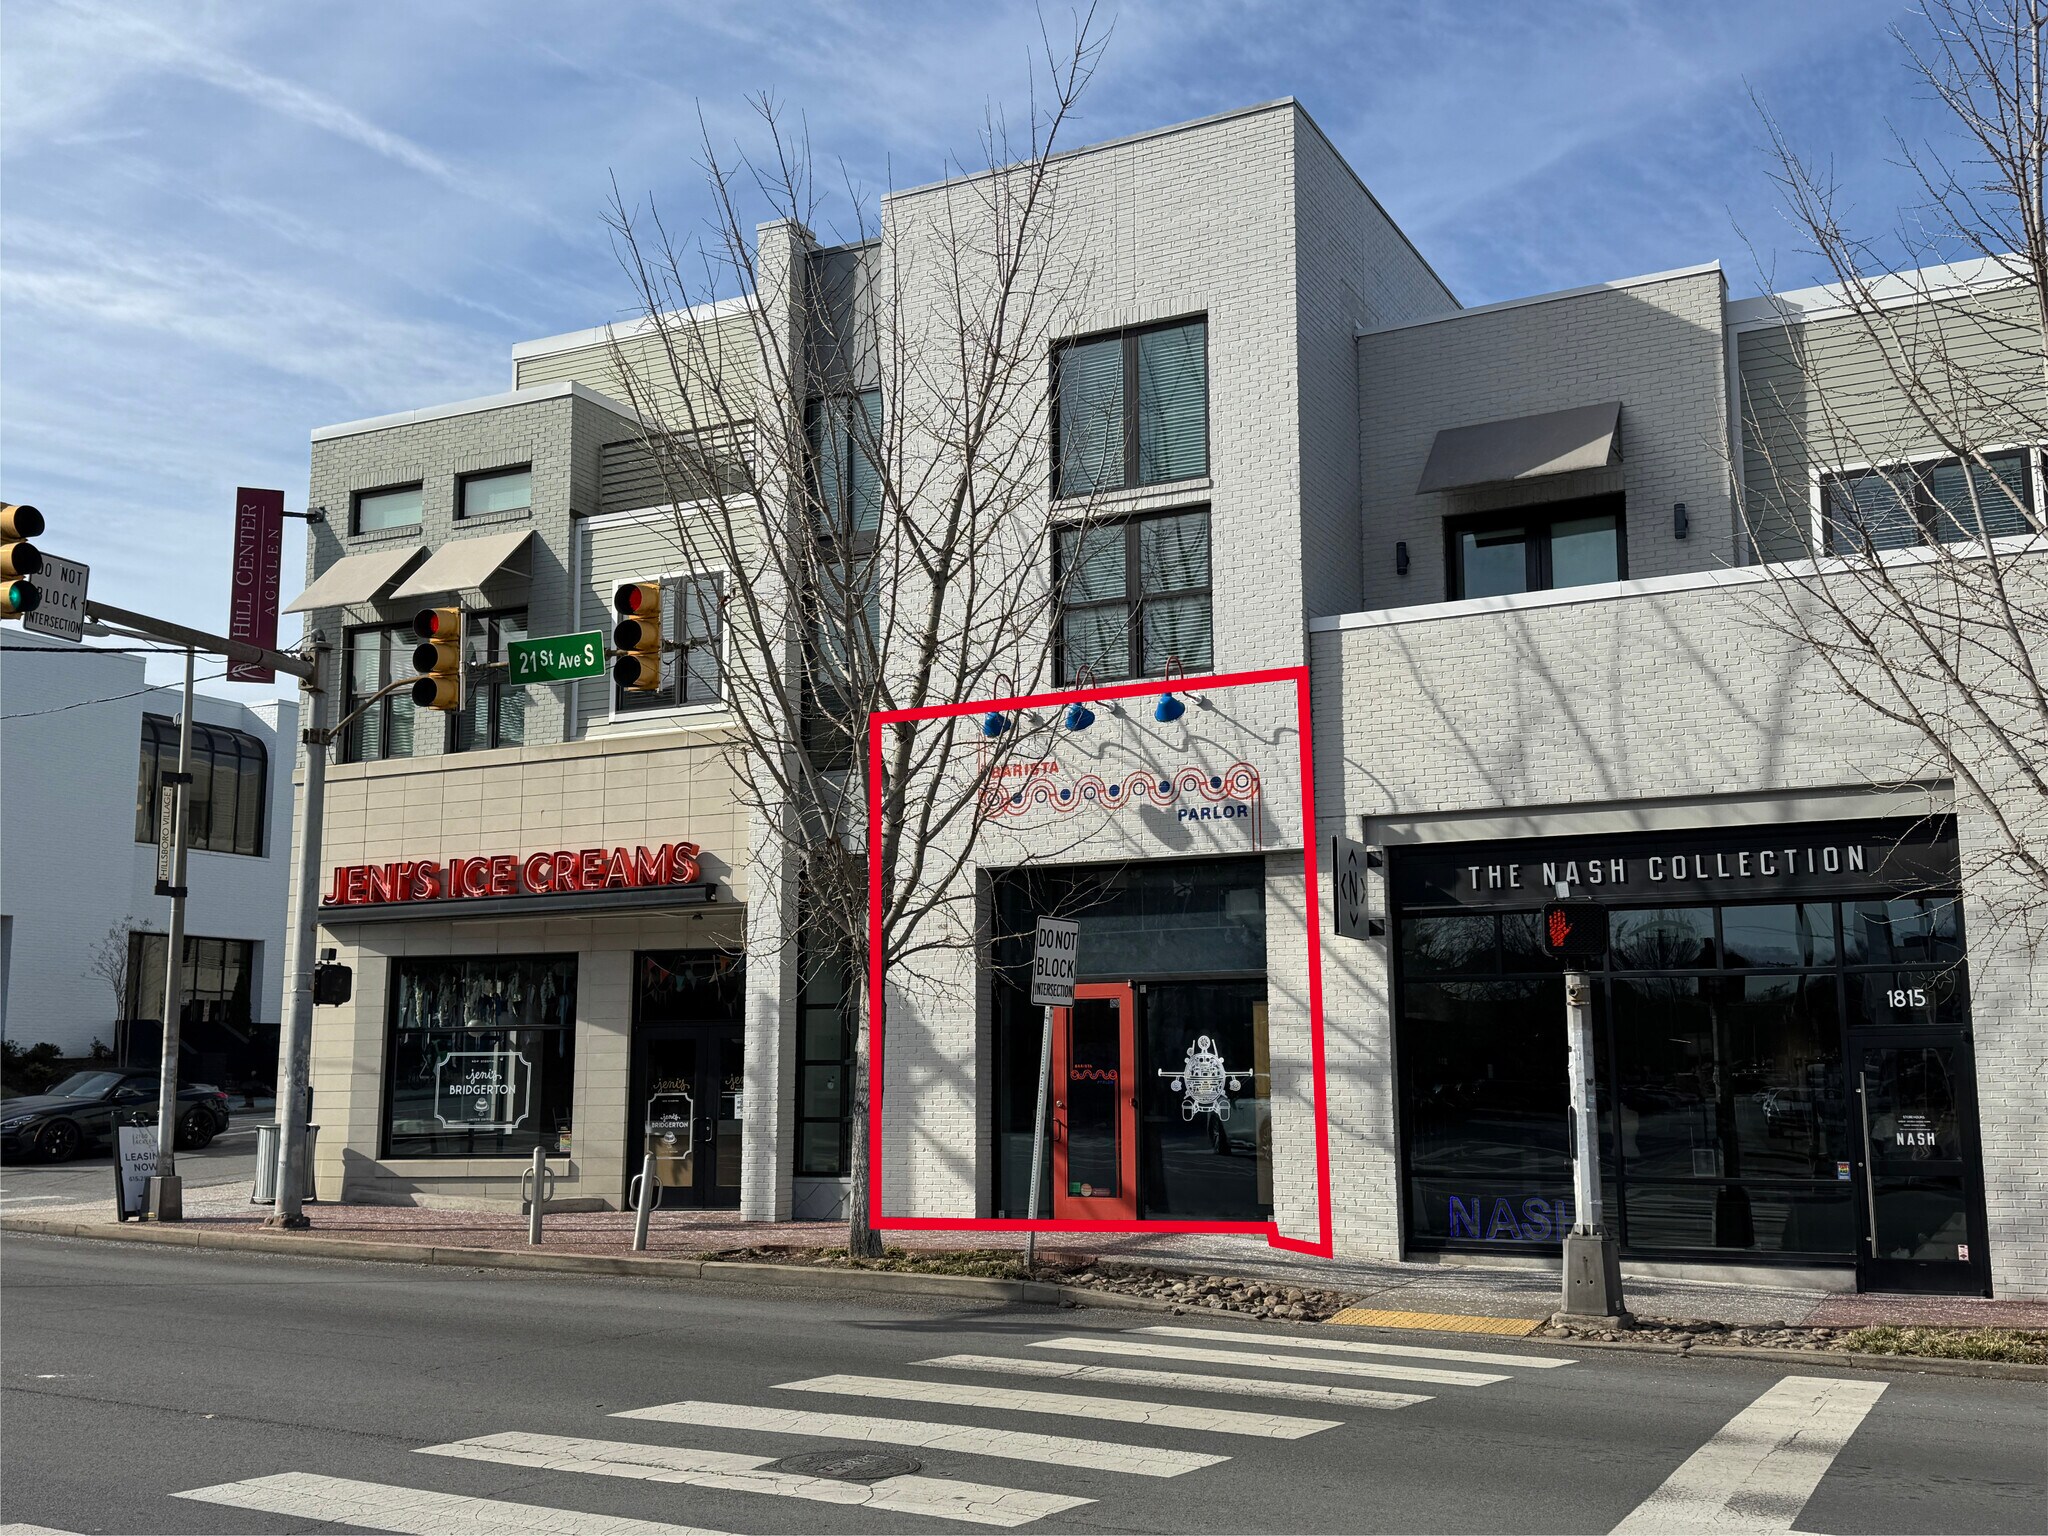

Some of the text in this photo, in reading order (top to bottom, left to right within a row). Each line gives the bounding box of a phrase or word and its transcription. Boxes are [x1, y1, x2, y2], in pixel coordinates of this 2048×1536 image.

[61, 567, 82, 586] NOT
[232, 504, 257, 638] HILL CENTER
[265, 528, 279, 617] ACKLEN
[558, 652, 581, 670] Ave
[584, 643, 595, 666] S
[991, 761, 1059, 778] BARISTA
[1178, 804, 1248, 821] PARLOR
[160, 791, 171, 876] HILLSBORO VILLAGE
[323, 841, 700, 906] JENI'S ICE CREAMS
[1468, 845, 1865, 890] THE NASH COLLECTION
[1039, 928, 1077, 951] DO NOT
[1036, 957, 1075, 979] BLOCK
[1034, 982, 1073, 998] INTERSECTION
[1886, 988, 1926, 1008] 1815
[465, 1068, 502, 1084] jeni's
[449, 1084, 516, 1095] BRIDGERTON
[1896, 1132, 1935, 1146] NASH
[1449, 1195, 1576, 1241] NASH
